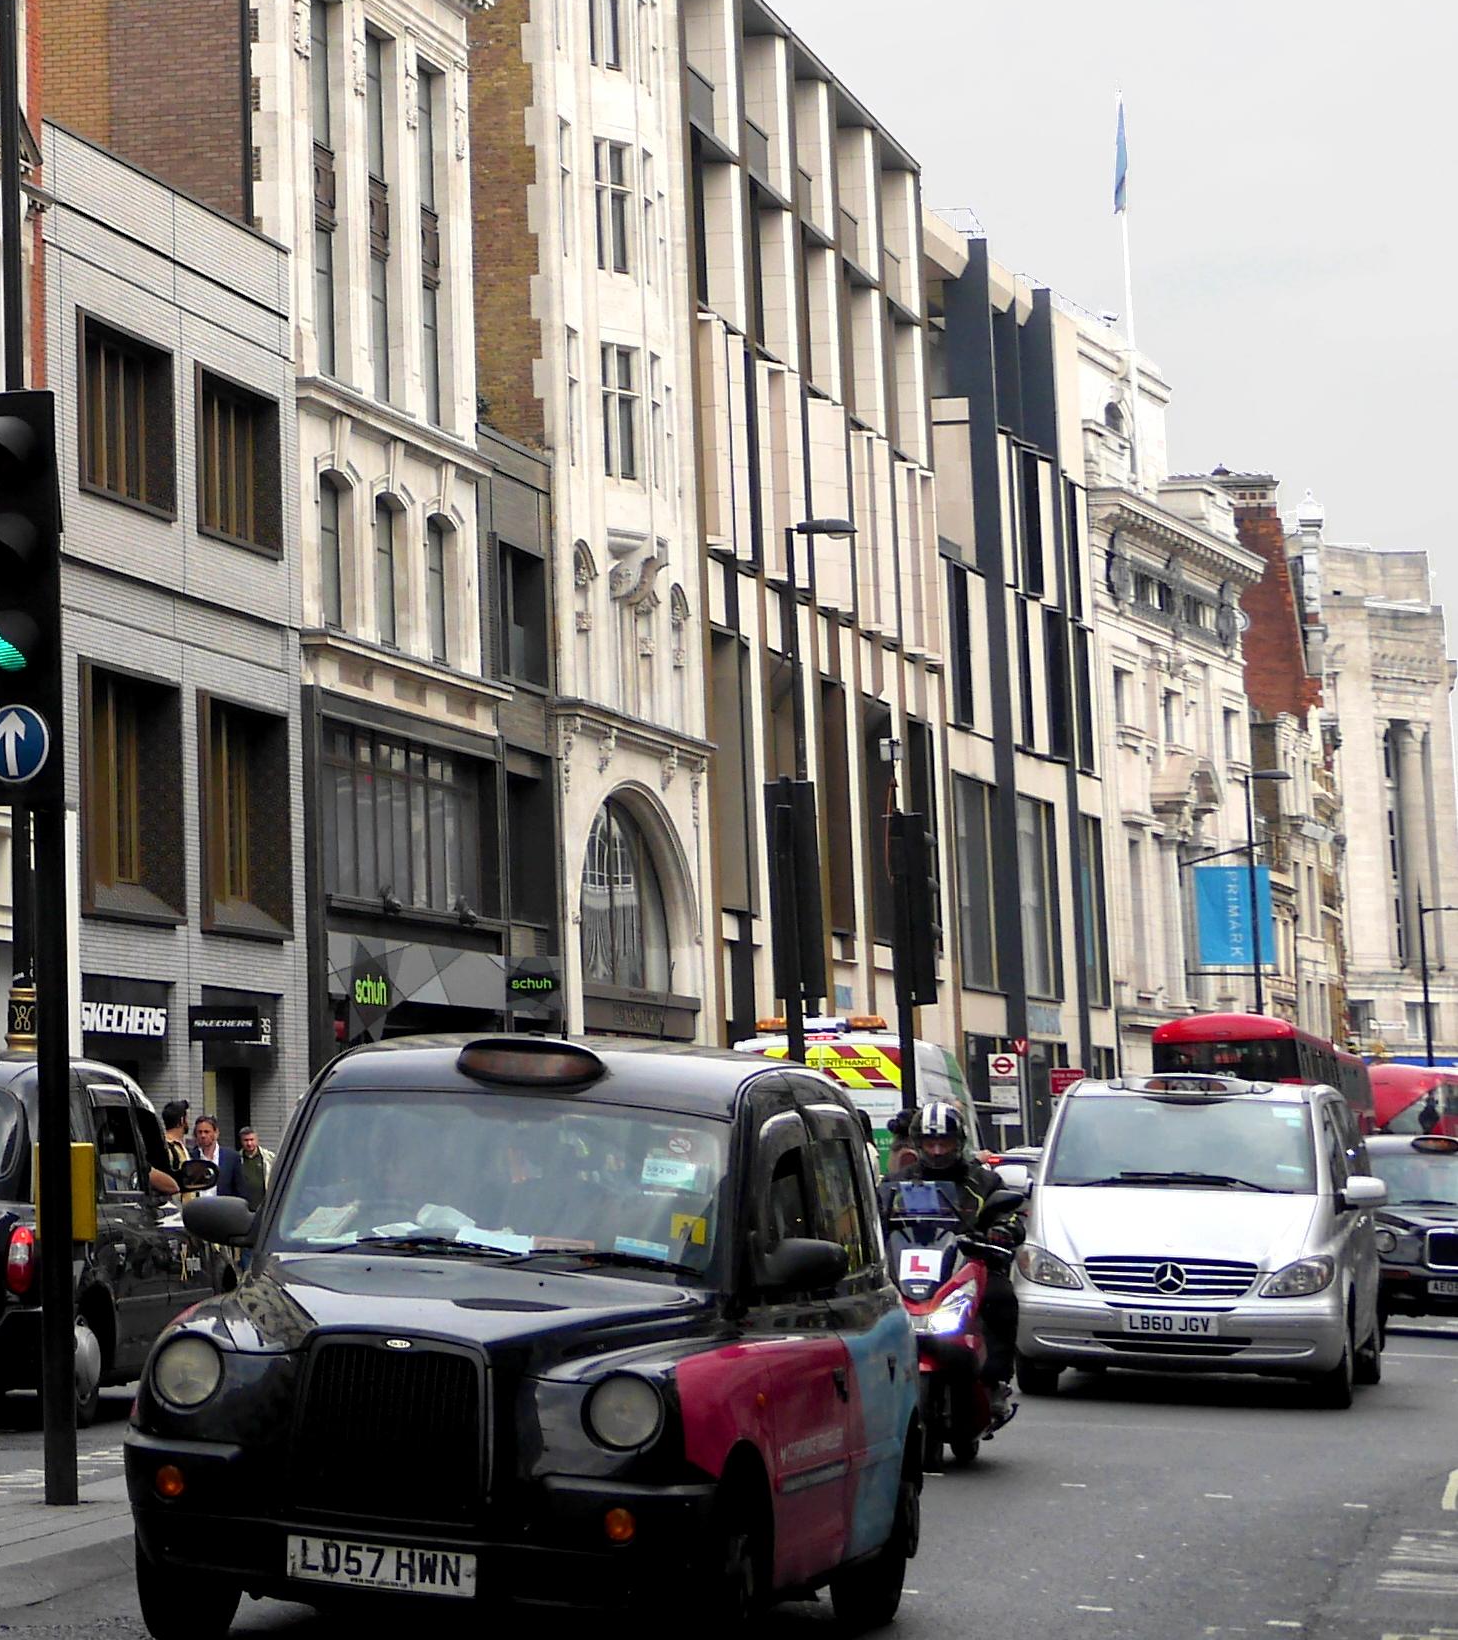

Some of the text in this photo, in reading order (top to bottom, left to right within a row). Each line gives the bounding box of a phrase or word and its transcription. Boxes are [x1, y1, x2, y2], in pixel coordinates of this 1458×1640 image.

[1225, 871, 1244, 959] PRIMARK
[355, 975, 388, 1006] schuh
[511, 978, 553, 990] schuh
[81, 1001, 167, 1037] SKECHERS
[193, 1018, 254, 1027] SKECHERS
[910, 1256, 930, 1272] L
[1129, 1315, 1210, 1333] LB60 JGV
[301, 1539, 461, 1587] LD57 HWN
